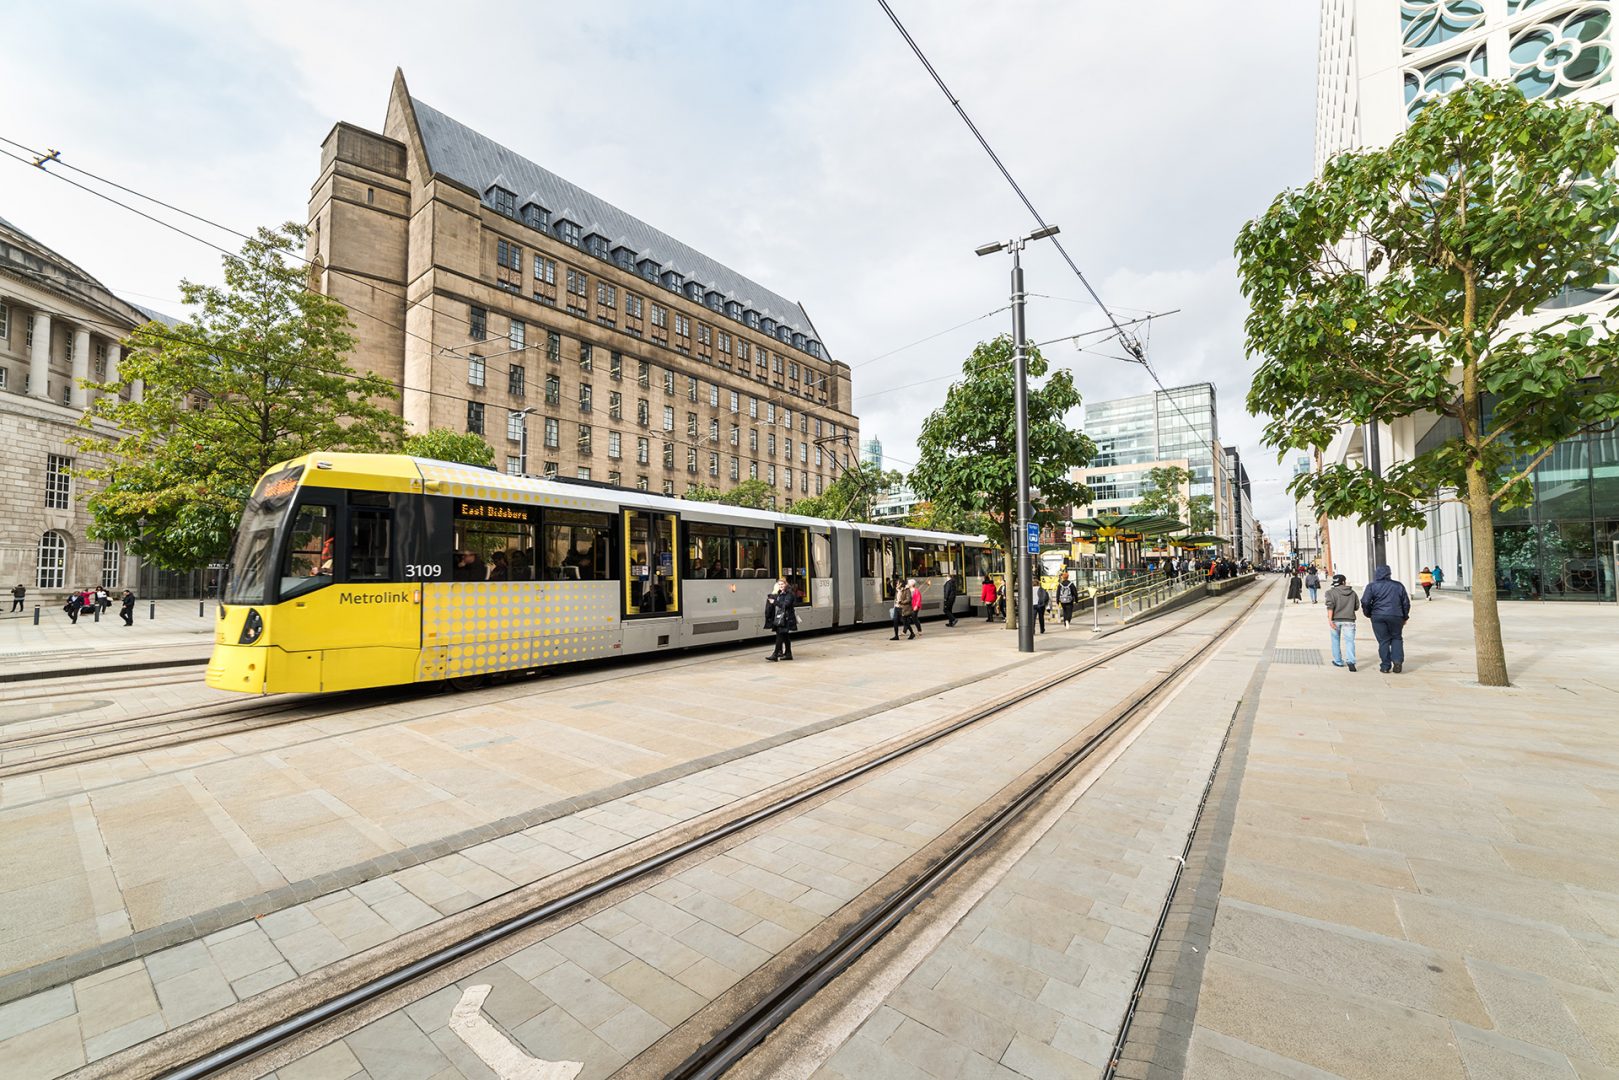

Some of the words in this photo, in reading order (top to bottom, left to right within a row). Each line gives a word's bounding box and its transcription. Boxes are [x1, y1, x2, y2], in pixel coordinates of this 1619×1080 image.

[461, 503, 484, 516] East
[487, 506, 528, 520] Didsbury
[405, 564, 442, 577] 3109
[339, 591, 409, 605] Metrolink
